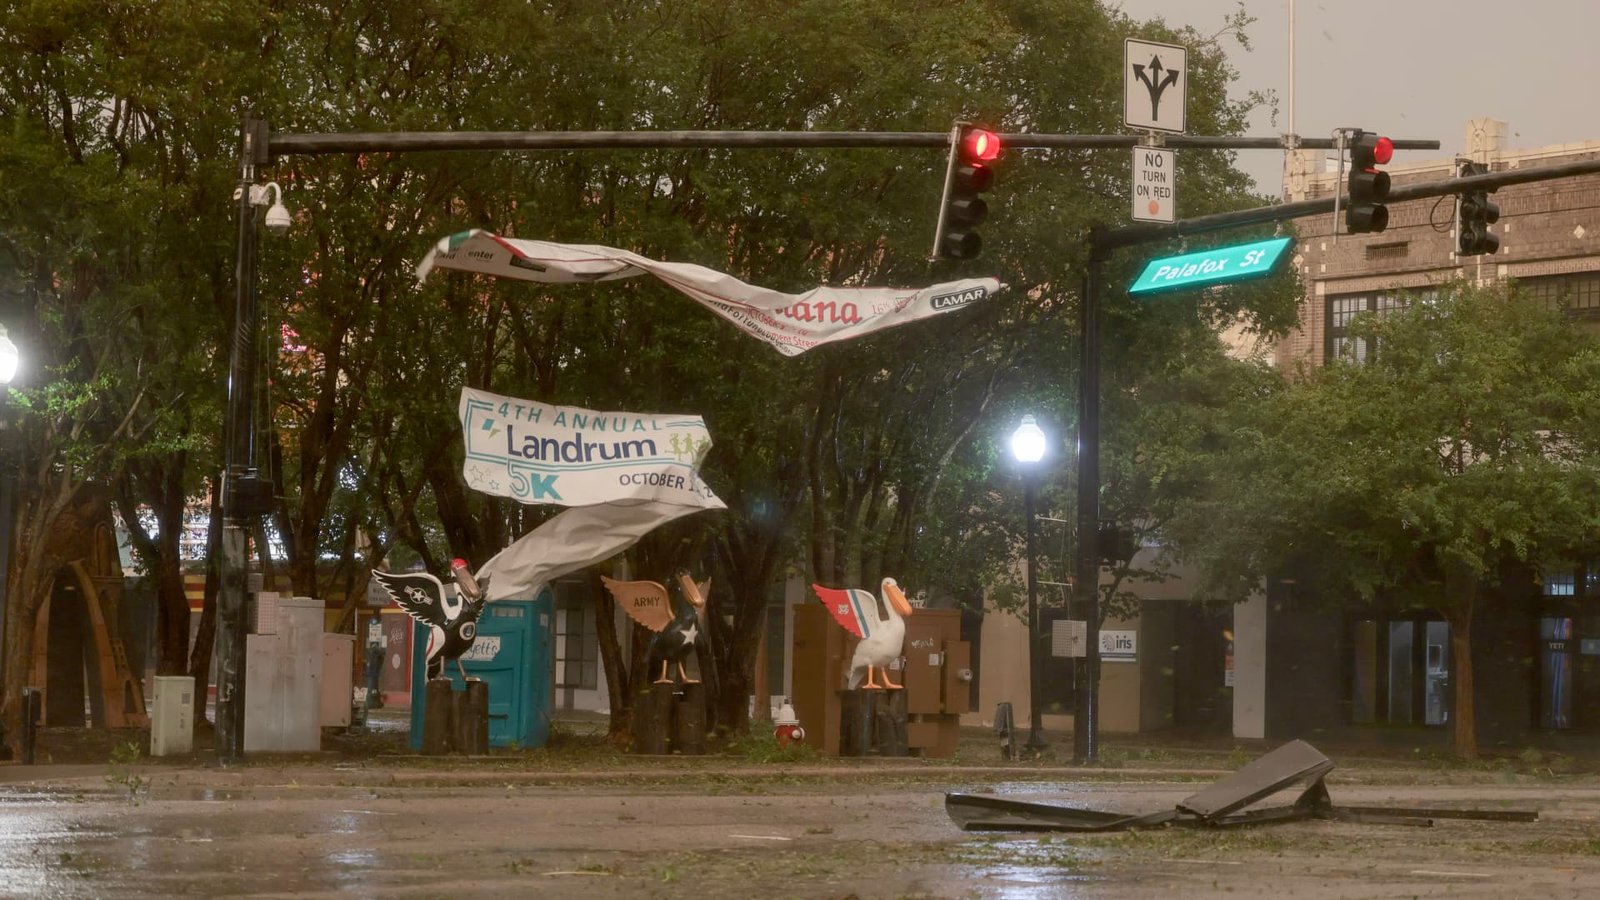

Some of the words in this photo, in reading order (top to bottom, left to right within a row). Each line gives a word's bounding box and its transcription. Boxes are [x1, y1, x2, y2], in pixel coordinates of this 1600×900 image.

[1145, 153, 1163, 168] NO
[1142, 169, 1166, 183] TURN
[1136, 186, 1150, 197] ON
[1153, 186, 1171, 199] RED
[1151, 258, 1230, 282] Palafox
[1239, 249, 1265, 267] St
[934, 289, 984, 309] LAMAR
[498, 402, 543, 423] 4TH
[553, 411, 662, 433] ANNUAL
[507, 424, 657, 462] Landrum
[507, 459, 563, 501] 5K
[619, 472, 685, 490] OCTOBER
[634, 597, 660, 607] ARMY
[1116, 635, 1132, 649] iris
[1549, 642, 1565, 650] YETI
